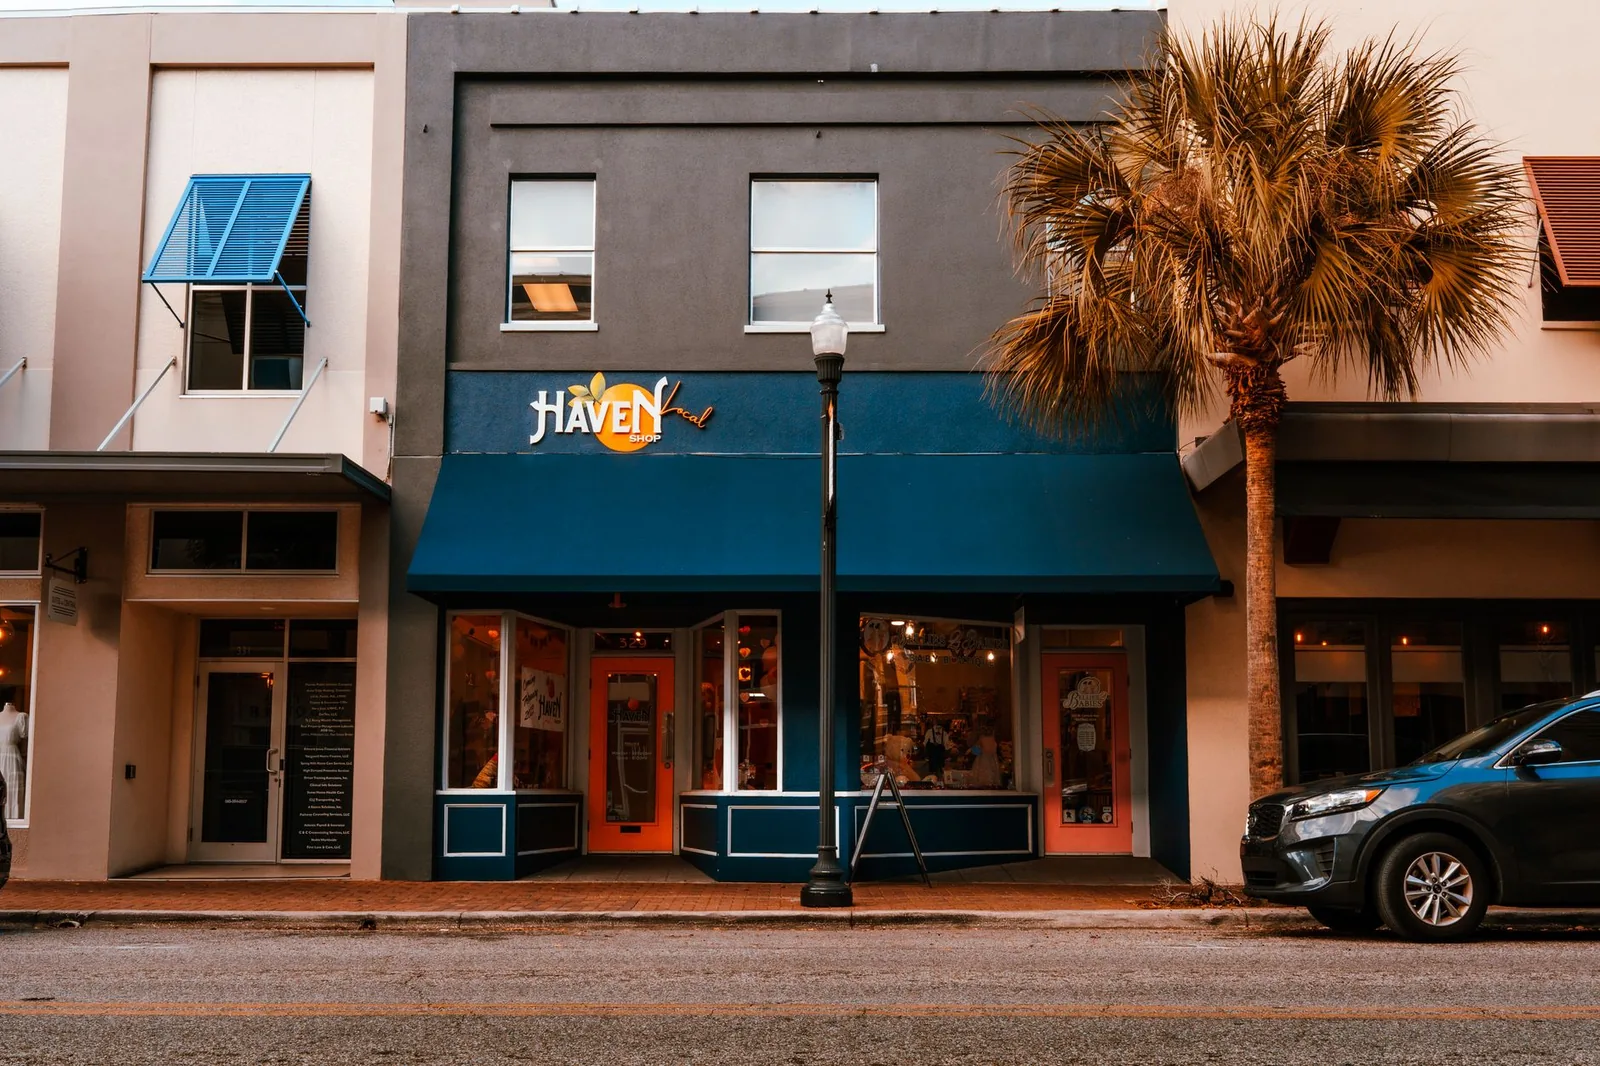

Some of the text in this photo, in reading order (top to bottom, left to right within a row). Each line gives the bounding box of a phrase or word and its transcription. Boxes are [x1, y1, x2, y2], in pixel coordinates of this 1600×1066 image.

[530, 376, 714, 445] HAVEN Local
[629, 434, 662, 444] SHOP
[909, 653, 939, 664] BABY
[538, 691, 563, 721] HAVEN
[611, 704, 653, 724] HAVEN
